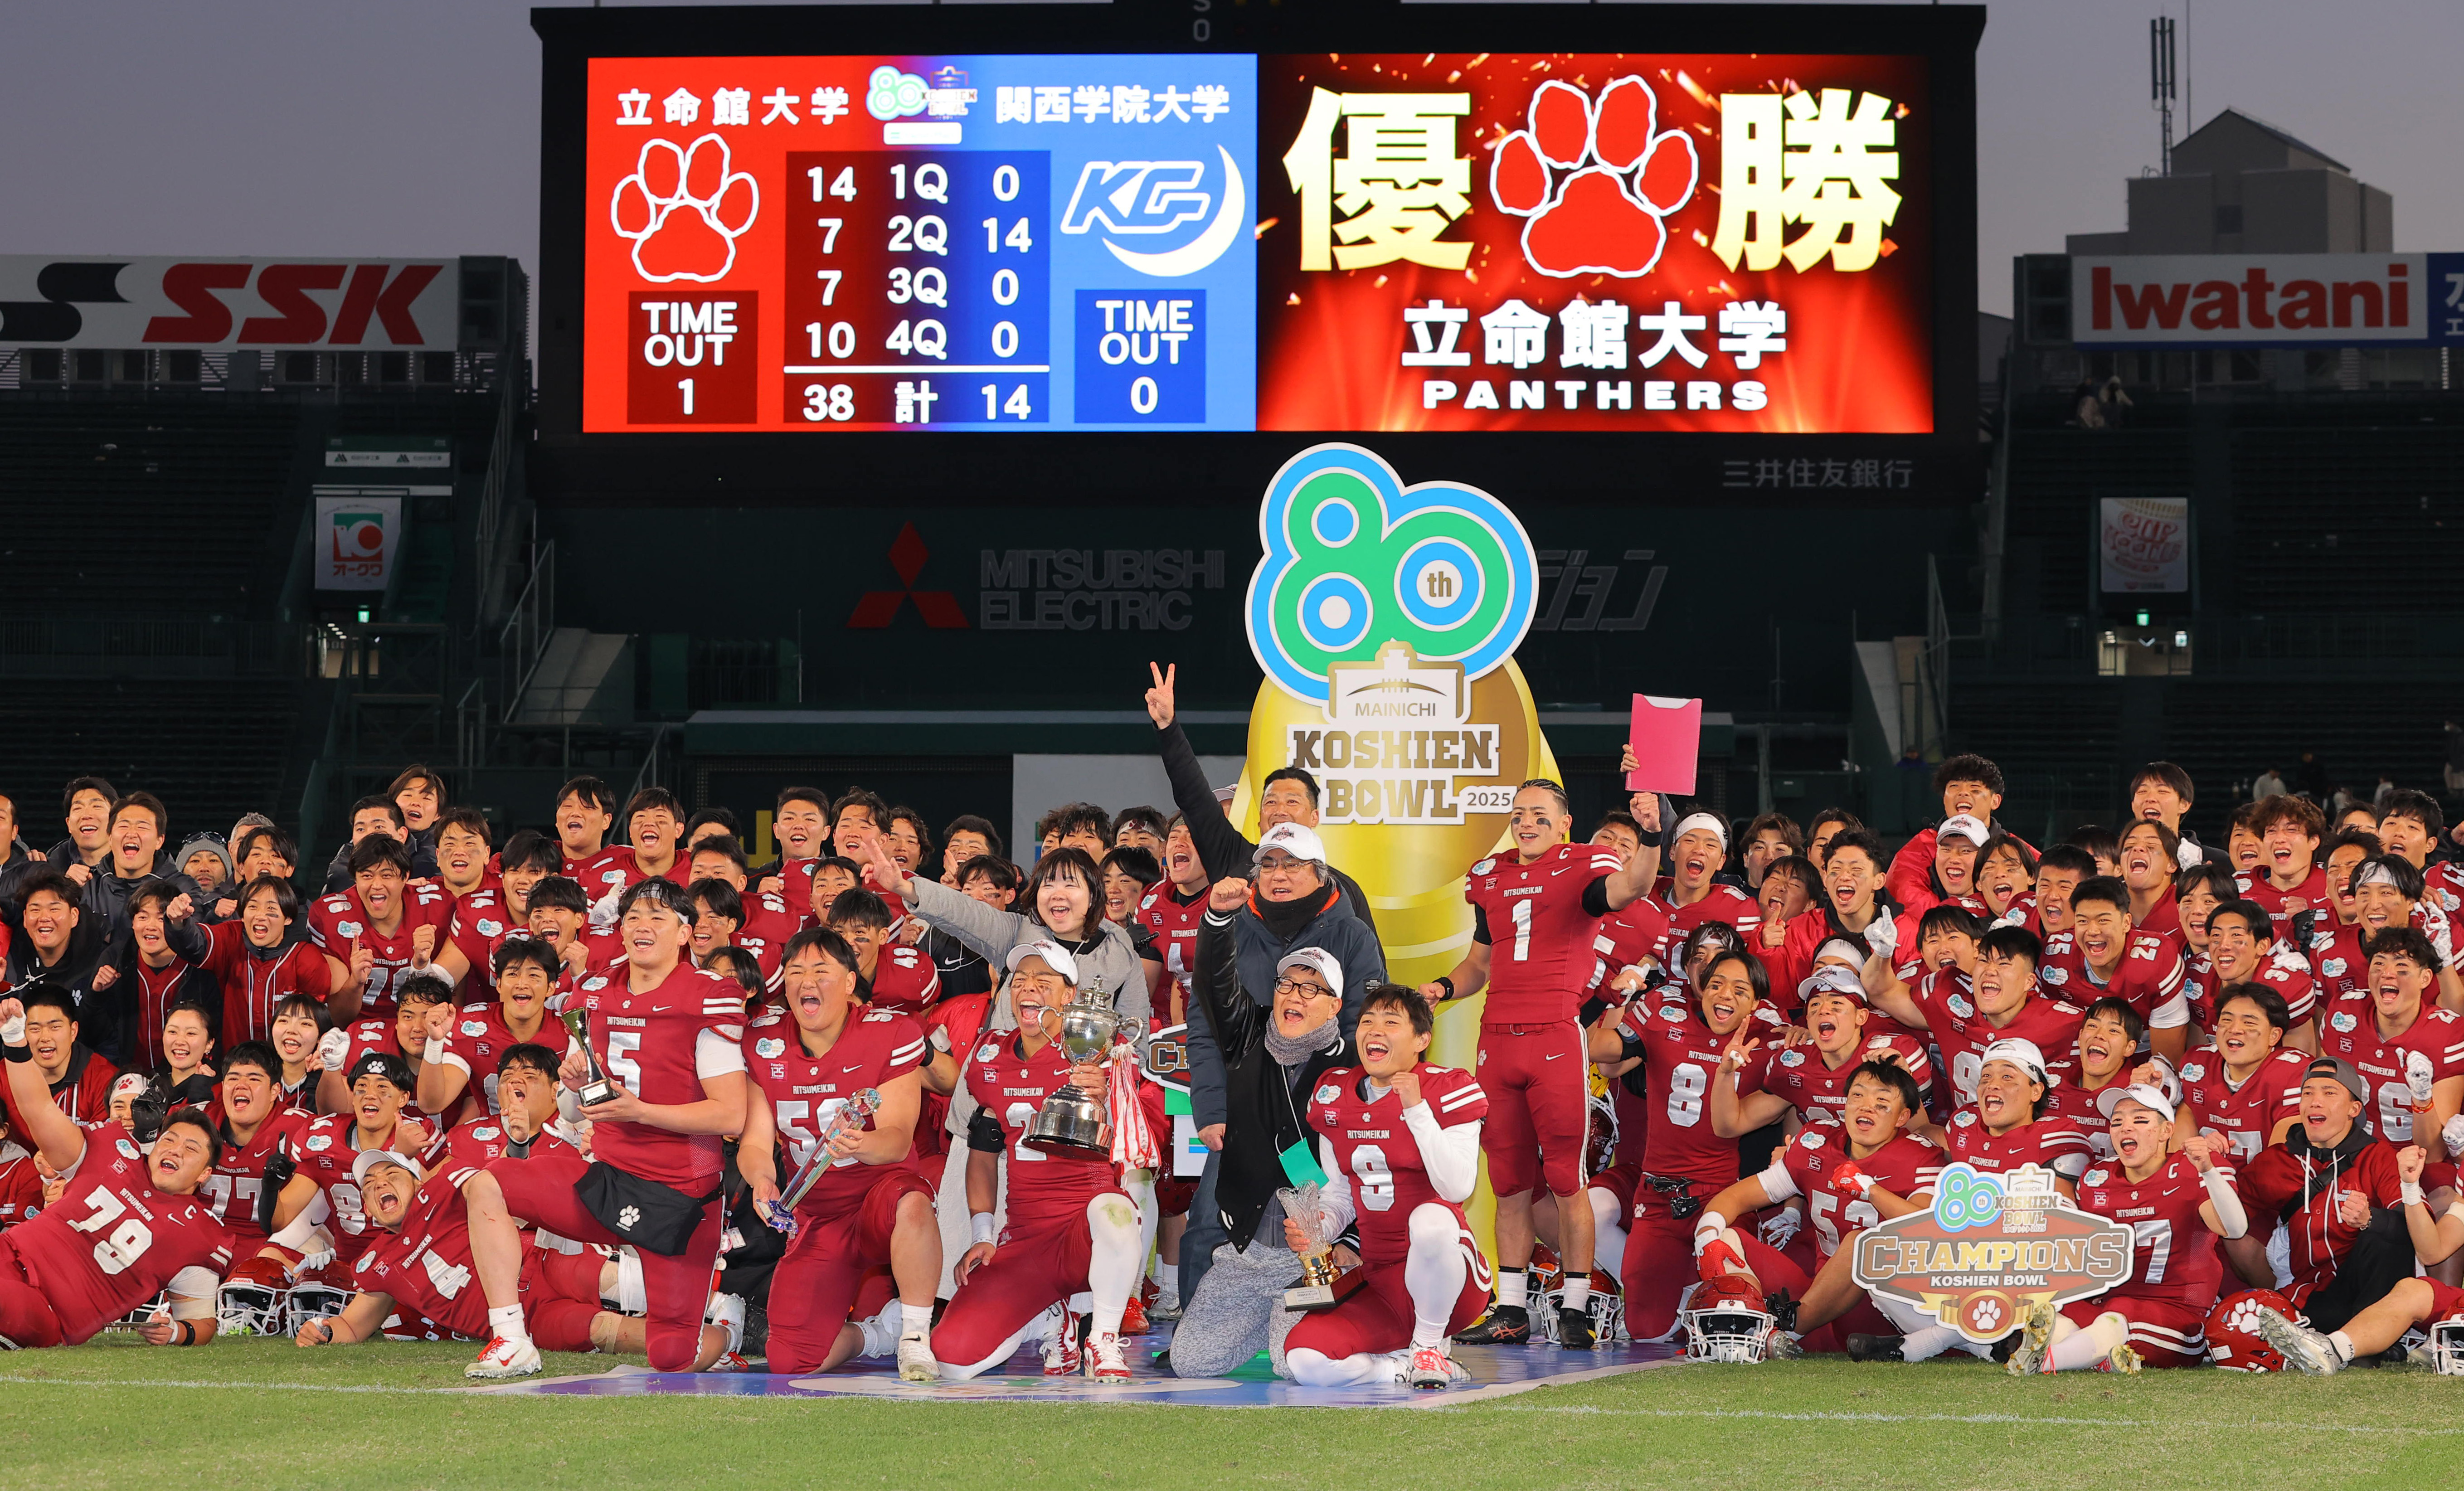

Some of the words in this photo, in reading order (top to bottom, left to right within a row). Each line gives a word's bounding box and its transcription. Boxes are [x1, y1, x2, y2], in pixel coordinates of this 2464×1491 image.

[616, 87, 849, 126] 立命館大学
[996, 85, 1230, 123] 関西学院大学
[807, 166, 857, 202] 14
[890, 163, 948, 204] 1Q
[992, 165, 1020, 201] 0
[1282, 85, 1475, 271] 優
[1711, 88, 1903, 274] 勝
[818, 218, 843, 253] 7
[887, 215, 948, 256] 2Q
[982, 217, 1032, 253] 14
[817, 270, 842, 306] 7
[887, 267, 948, 308] 3Q
[991, 269, 1019, 306] 0
[2092, 263, 2408, 330] Iwatani
[141, 263, 444, 345] SSK
[641, 302, 738, 334] TIME
[1096, 300, 1194, 332] TIME
[806, 321, 855, 358] 10
[886, 319, 947, 360] 4Q
[991, 321, 1019, 358] 0
[1099, 333, 1189, 365] OUT
[1400, 299, 1787, 370] 立命館大学
[644, 334, 733, 366] OUT
[678, 378, 693, 414] 1
[803, 384, 855, 421] 38
[894, 380, 938, 423] 計
[982, 384, 1031, 420] 14
[1130, 376, 1158, 414] 0
[1422, 381, 1769, 410] PANTHERS
[1722, 458, 1914, 488] 三井住友銀行
[333, 564, 383, 577] オークワ
[981, 549, 1225, 589] MITSUBISHI
[1427, 571, 1452, 597] th
[981, 591, 1193, 630] ELECTRIC
[1355, 702, 1437, 717] MAINICHI
[1293, 730, 1492, 769] KOSHIEN
[1326, 779, 1458, 818] BOWL
[1467, 792, 1511, 807] 2025
[1559, 847, 1572, 860] C
[1503, 885, 1543, 898] RITSUMEIKAN
[1152, 915, 1163, 925] 125
[1171, 929, 1197, 937] RITSUMEIKA
[1511, 898, 1532, 962] 1
[606, 1016, 646, 1027] RITSUMEIKAN
[1666, 1029, 1685, 1042] 125
[476, 1045, 490, 1055] 125
[1688, 1050, 1722, 1063] RITSUMEIK
[2340, 1040, 2353, 1052] 125
[607, 1031, 642, 1099] 5
[770, 1067, 785, 1078] 125
[983, 1070, 997, 1082] 125
[2358, 1061, 2396, 1078] RITSUMEIKAN
[792, 1083, 836, 1095] RITSUMEIKAN
[1003, 1087, 1044, 1097] RITSUMEIKAN
[1788, 1076, 1802, 1087] 125
[1005, 1102, 1047, 1161] 2
[1324, 1113, 1338, 1125] 125
[1346, 1129, 1390, 1139] RITSUMEIKAN
[2208, 1113, 2242, 1127] RITSUMEIKAN
[1968, 1155, 2000, 1169] RITSUMEIKAN
[2168, 1162, 2180, 1180] C
[1351, 1144, 1395, 1211] 9
[119, 1187, 155, 1222] RITSUMEIKAN
[417, 1189, 430, 1204] C
[1994, 1195, 2058, 1210] KOSHIEN
[2094, 1195, 2107, 1206] 125
[185, 1204, 197, 1220] C
[2003, 1210, 2047, 1226] BOWL
[2115, 1206, 2155, 1218] RITSUMEIKAN
[66, 1184, 153, 1275] 79
[401, 1233, 434, 1269] RITSUMEIKAN
[1860, 1232, 2128, 1280] CHAMPIONS
[2133, 1219, 2172, 1284] 7
[421, 1248, 472, 1300] 4
[1930, 1275, 1999, 1287] KOSHIEN
[2003, 1274, 2048, 1286] BOWL
